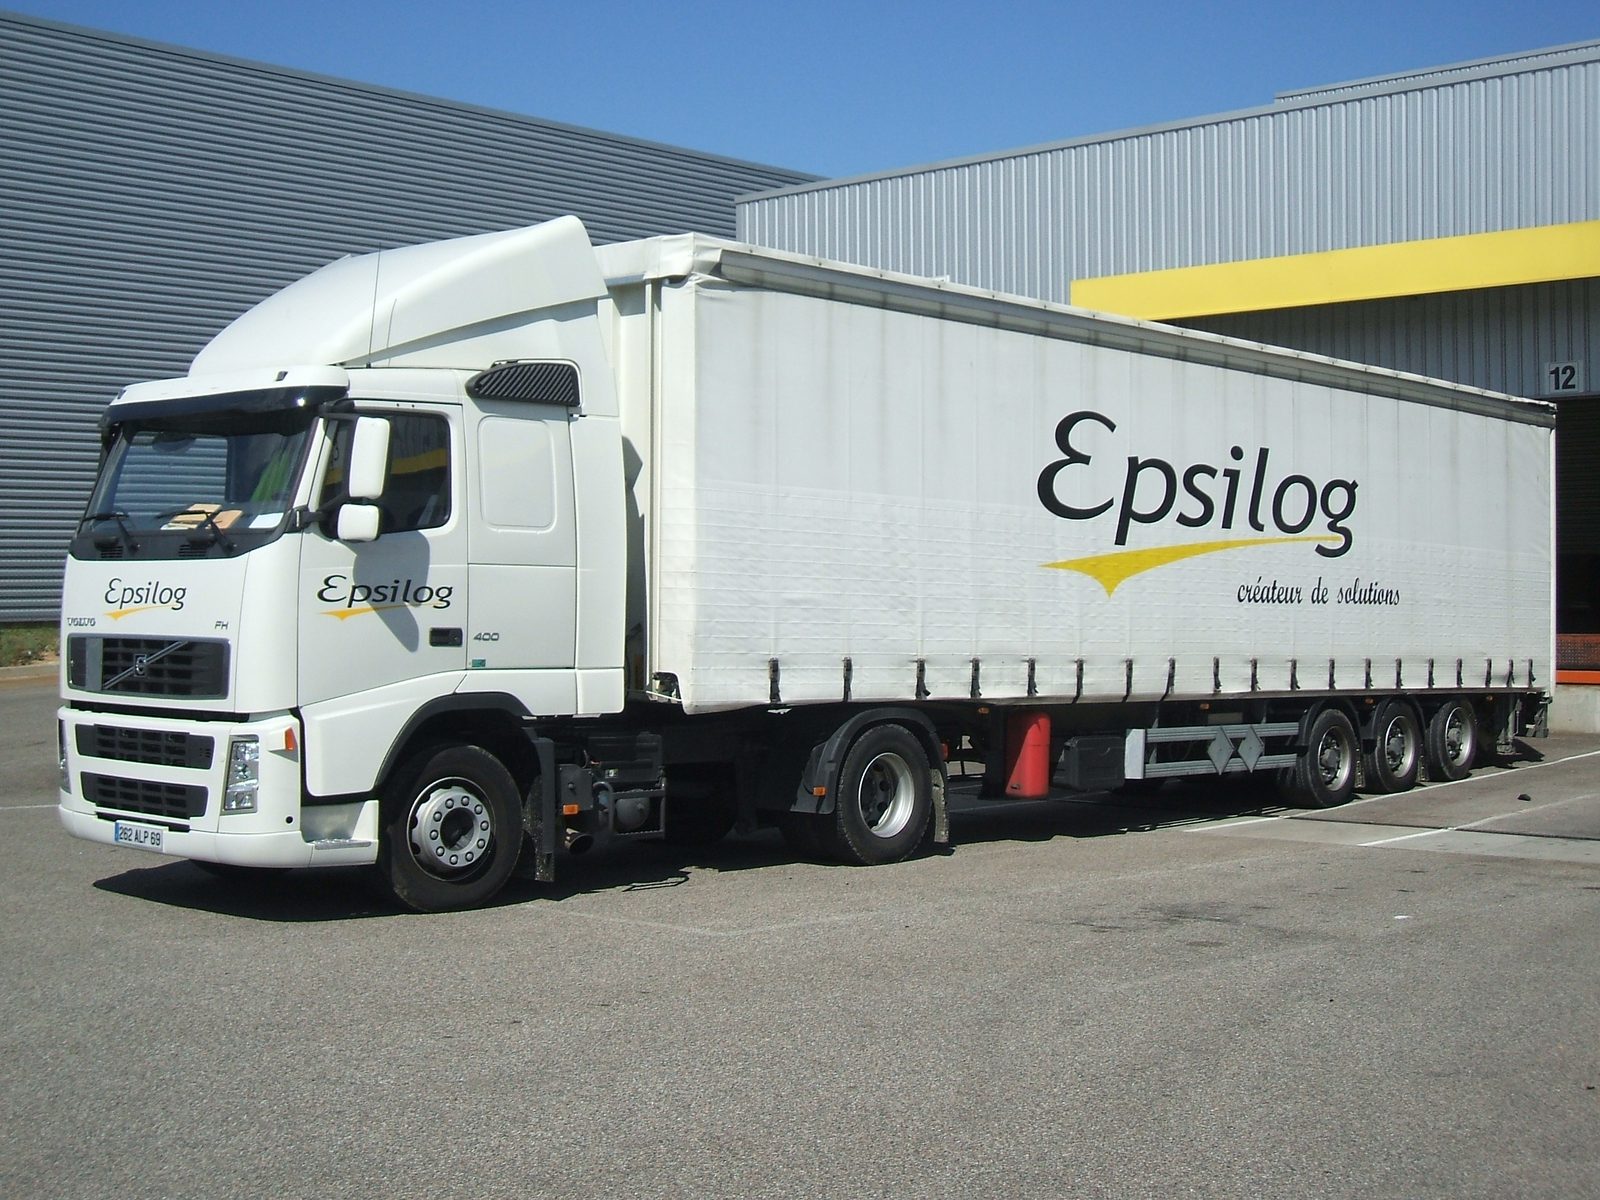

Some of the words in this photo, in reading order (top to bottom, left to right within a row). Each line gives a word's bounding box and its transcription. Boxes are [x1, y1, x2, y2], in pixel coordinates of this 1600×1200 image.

[1549, 365, 1576, 390] 12
[1037, 410, 1359, 558] Epsilog
[104, 577, 187, 611] Epsilog
[316, 574, 453, 609] Epsilog
[1237, 576, 1303, 604] créateur
[1311, 576, 1329, 605] de
[1337, 577, 1400, 606] solutions
[67, 617, 97, 627] VOLVO
[214, 620, 229, 631] FH
[473, 632, 500, 642] 400
[119, 826, 133, 842] 262
[134, 829, 149, 844] ALP
[150, 831, 161, 846] 69
